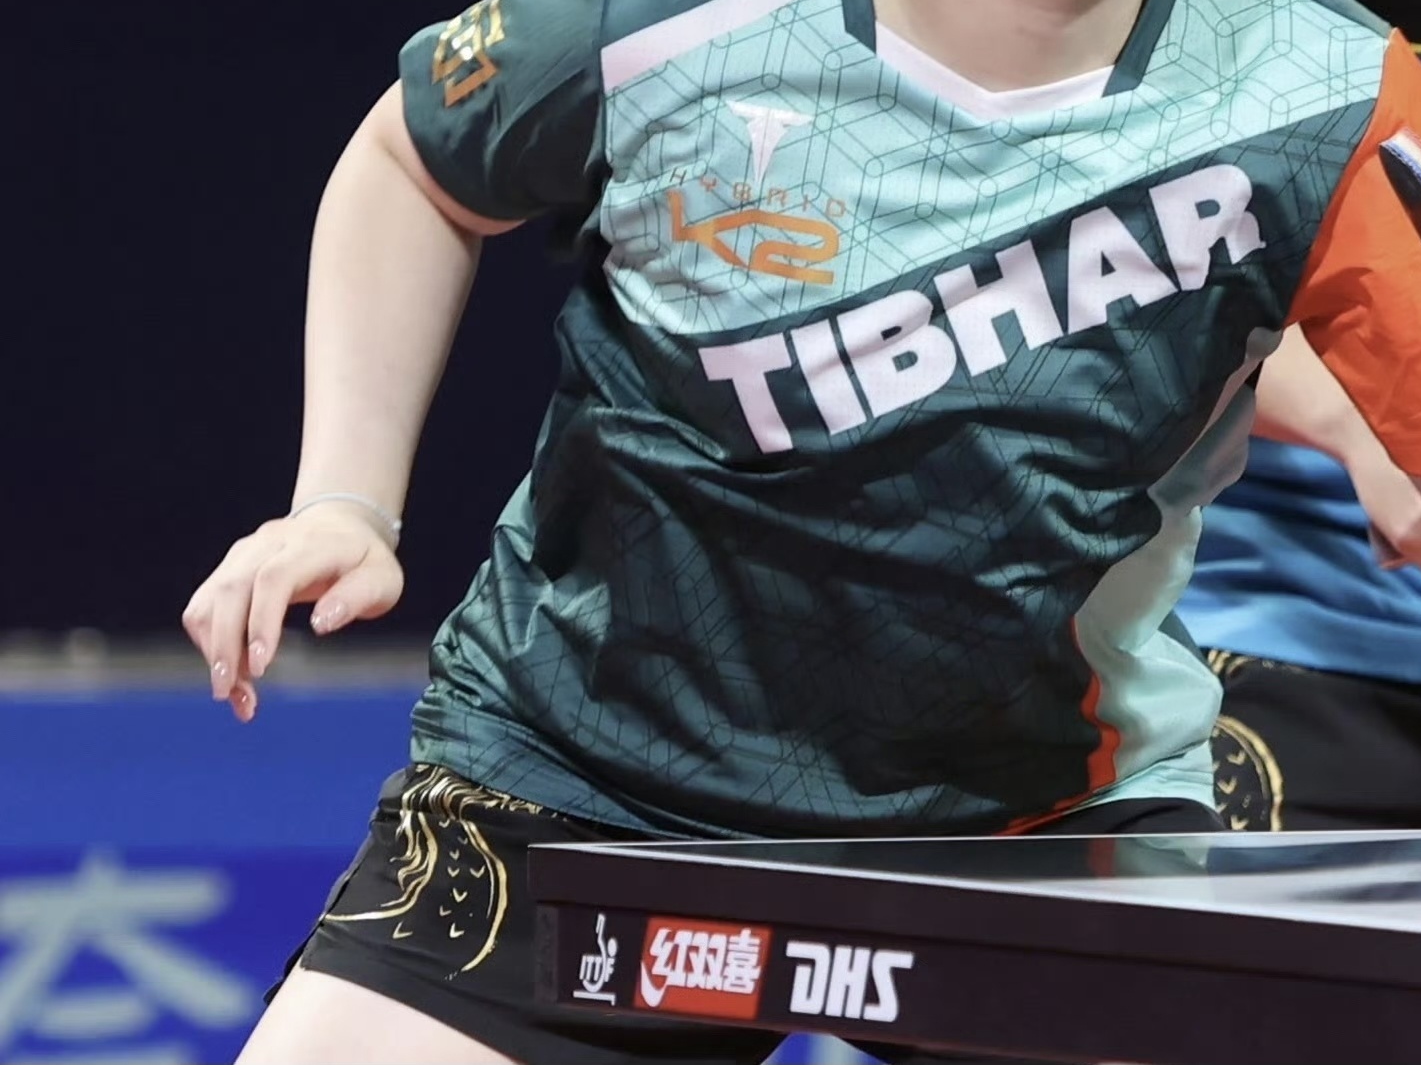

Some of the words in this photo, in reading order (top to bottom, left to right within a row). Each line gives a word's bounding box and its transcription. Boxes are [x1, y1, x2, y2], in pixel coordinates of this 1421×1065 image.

[670, 166, 845, 217] HYBRID
[699, 163, 1267, 454] TIBHAR
[639, 927, 763, 1009] 红双喜
[785, 939, 915, 1023] DHS
